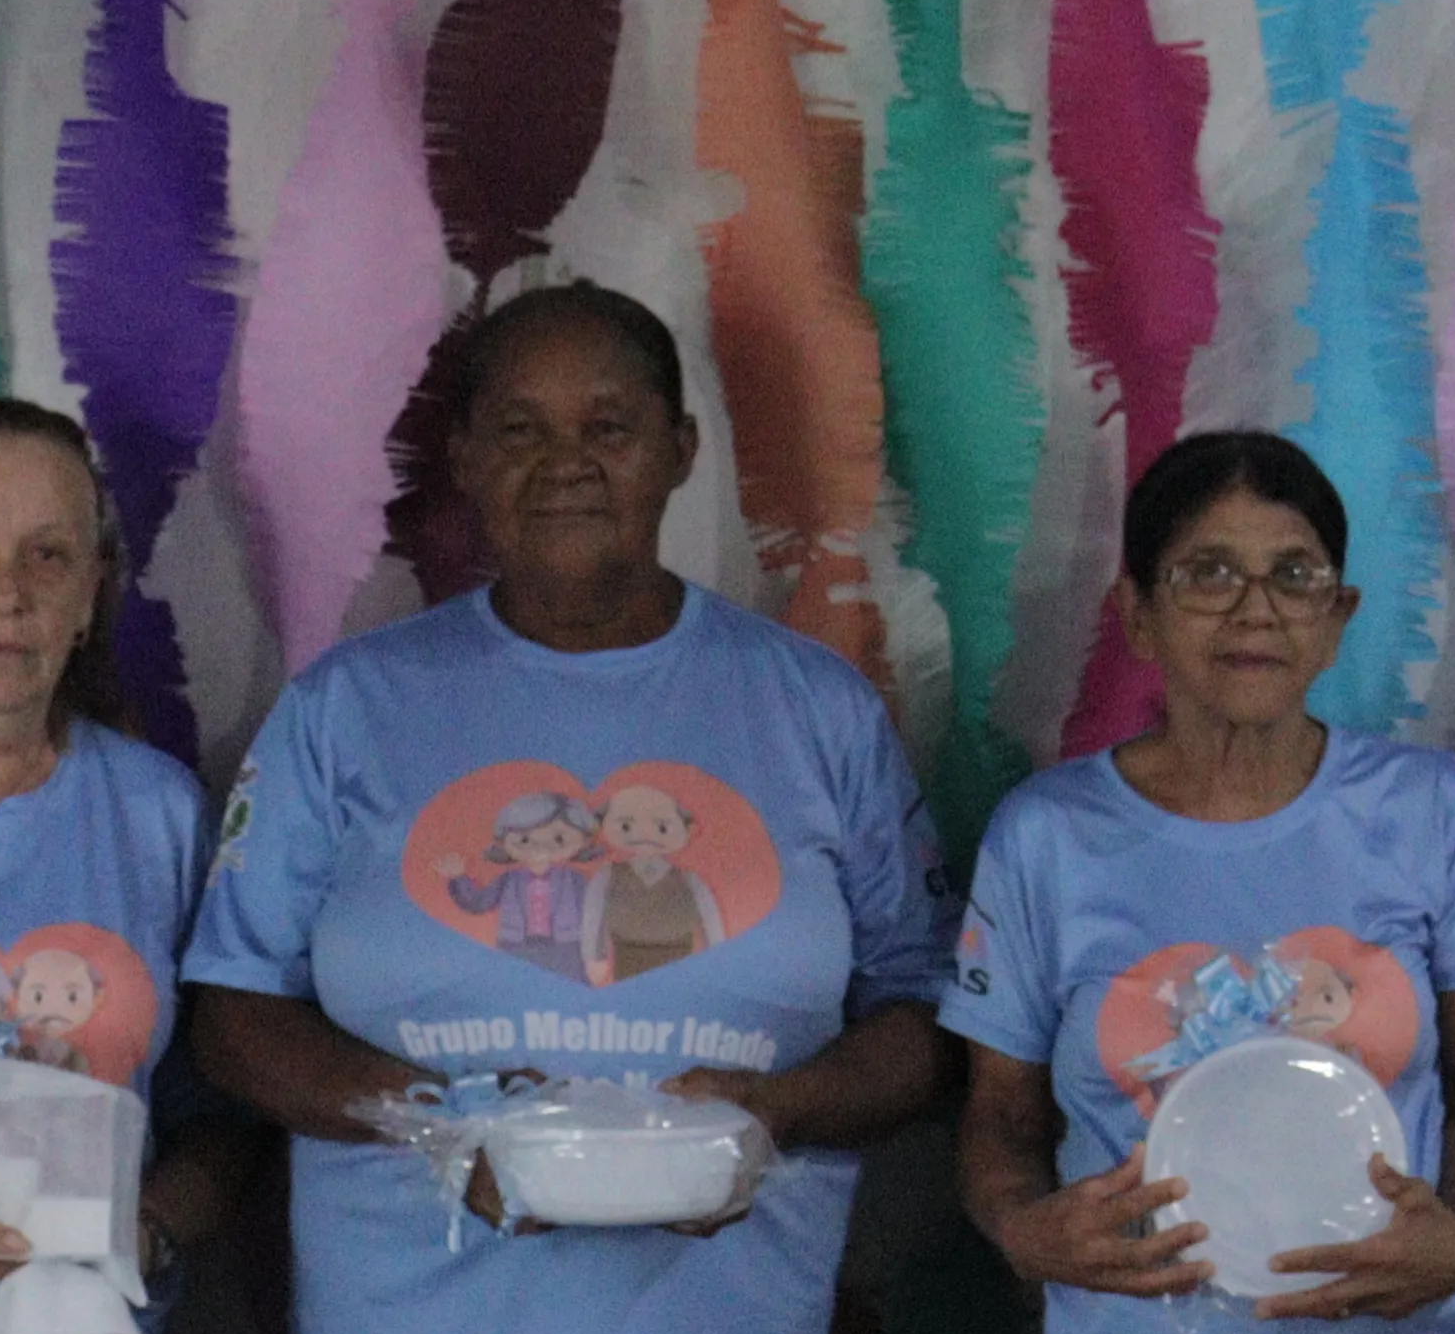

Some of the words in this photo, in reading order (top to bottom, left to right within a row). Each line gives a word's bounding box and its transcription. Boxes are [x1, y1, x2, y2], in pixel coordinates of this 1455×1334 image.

[396, 1016, 516, 1059] Grupo
[522, 1010, 675, 1054] Melhor
[681, 1016, 778, 1073] Idade
